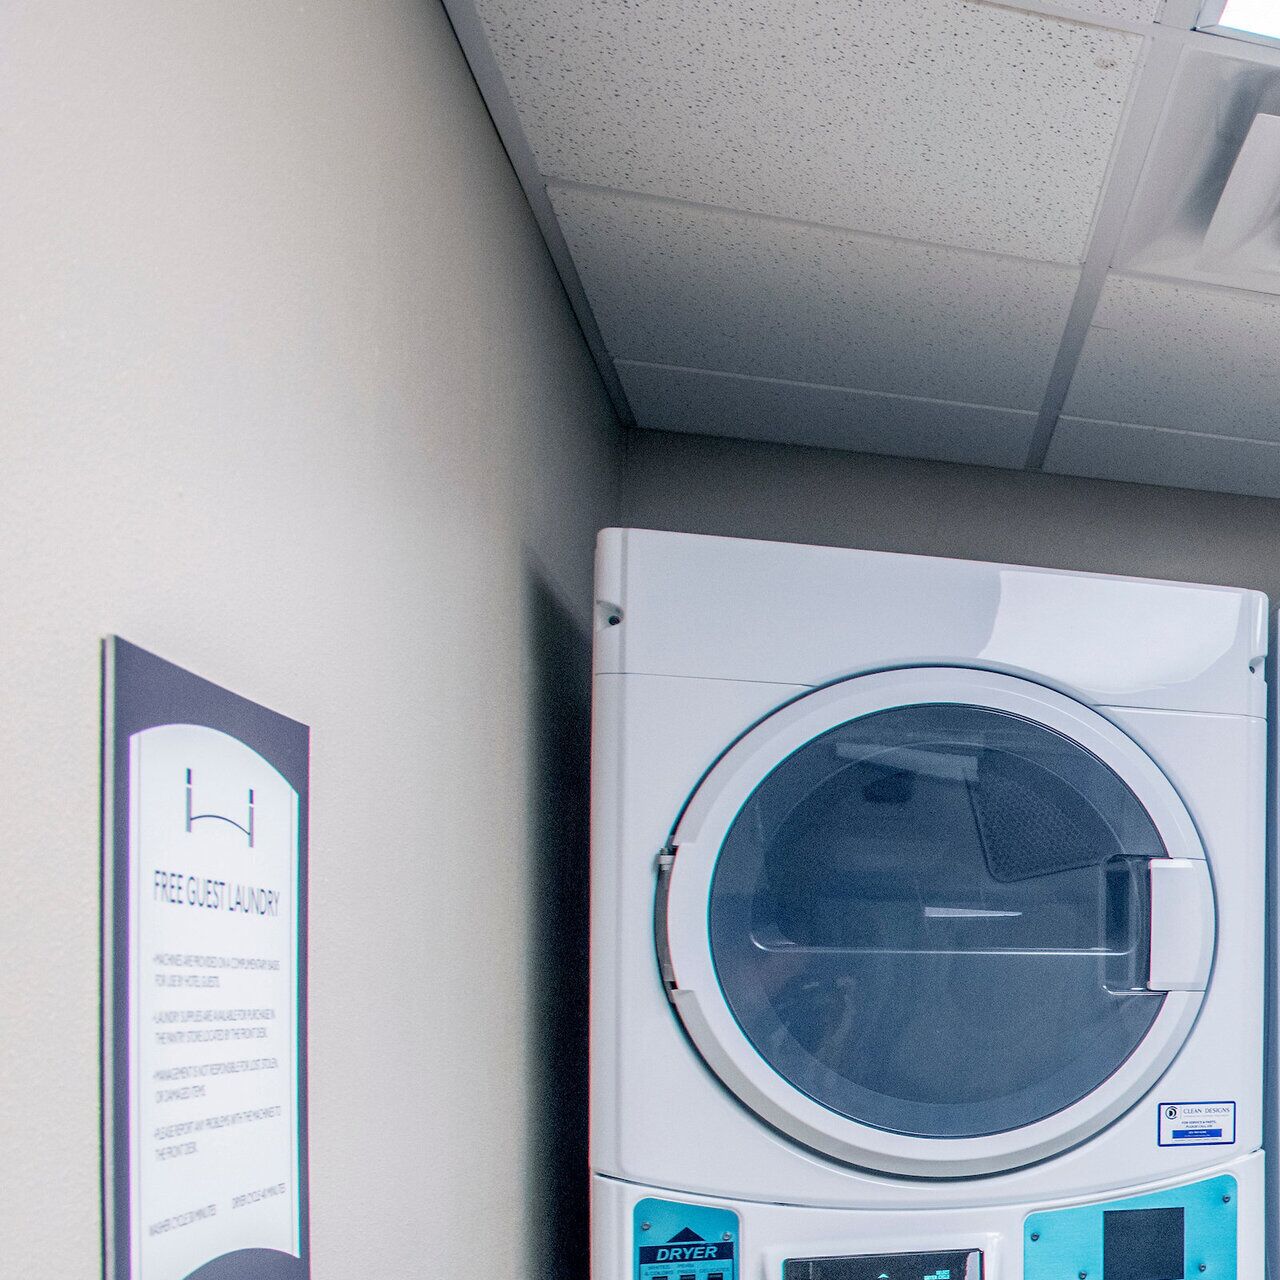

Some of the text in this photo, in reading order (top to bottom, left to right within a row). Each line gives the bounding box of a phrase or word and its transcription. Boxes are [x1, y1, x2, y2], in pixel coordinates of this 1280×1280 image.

[155, 869, 281, 917] FREE GUEST LAUNDRY
[656, 1246, 718, 1261] DRYER
